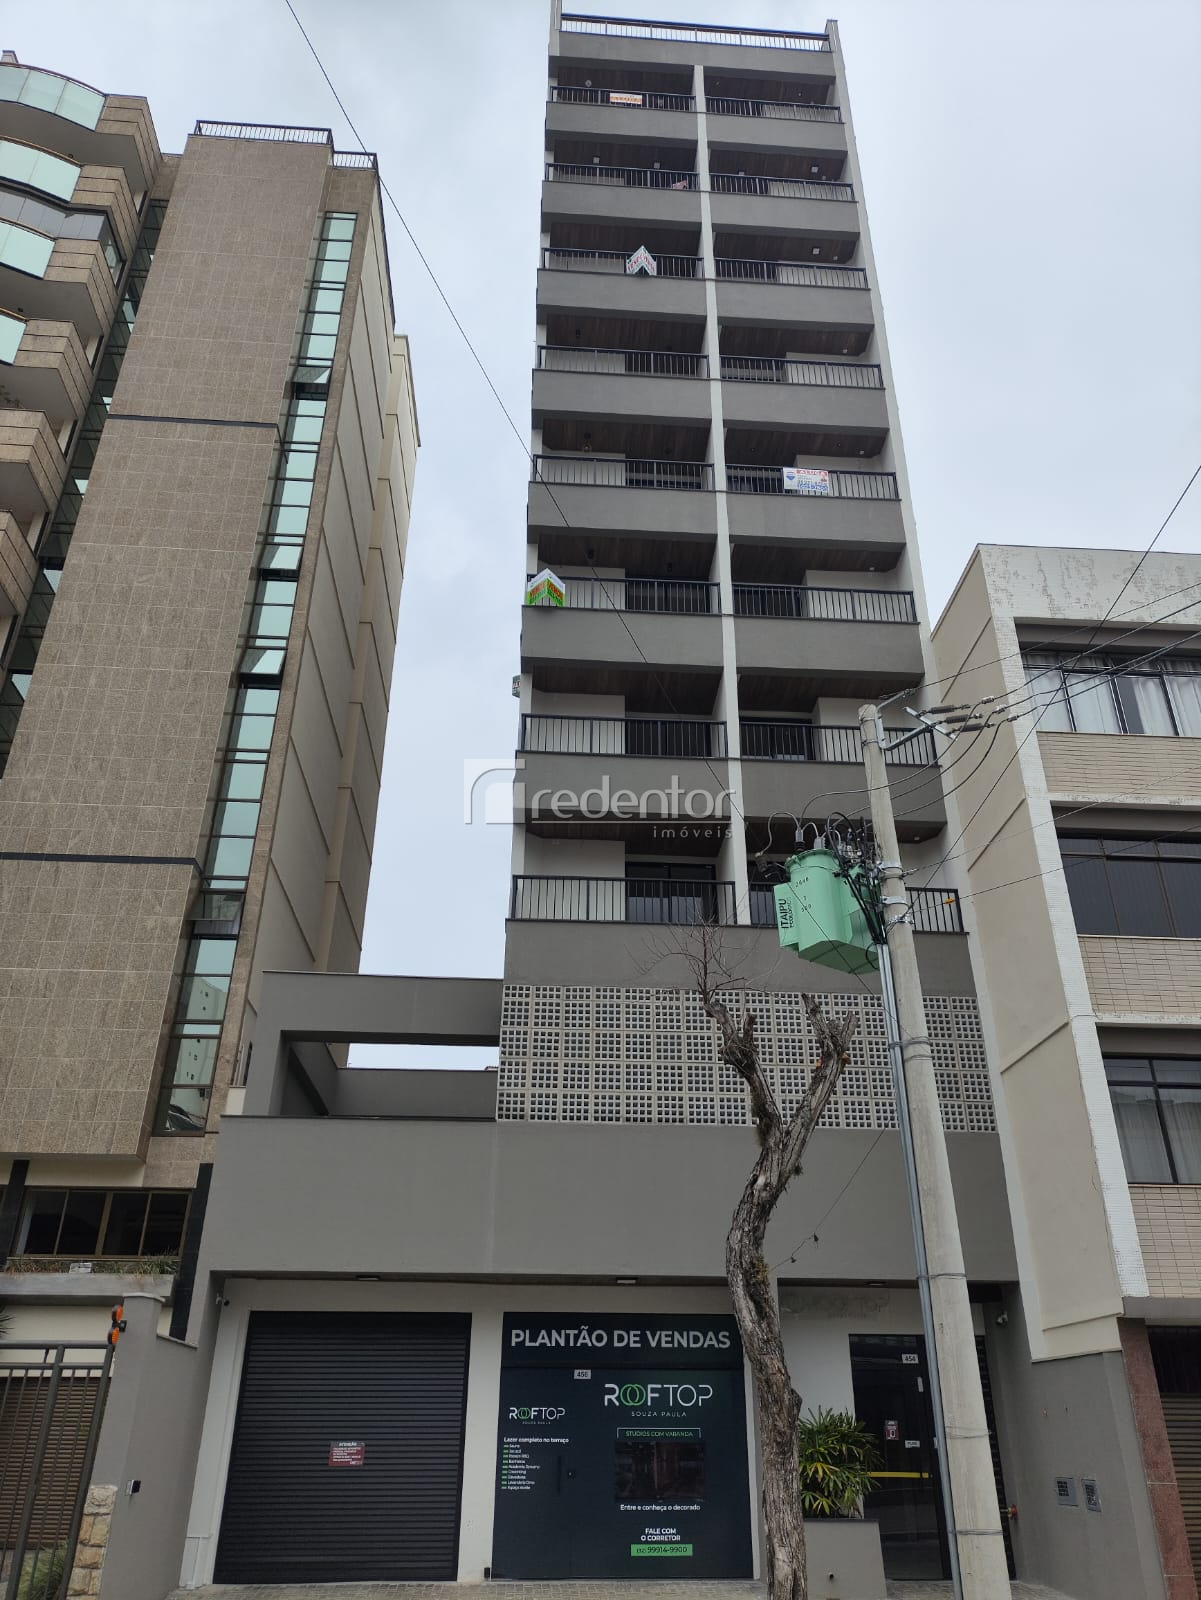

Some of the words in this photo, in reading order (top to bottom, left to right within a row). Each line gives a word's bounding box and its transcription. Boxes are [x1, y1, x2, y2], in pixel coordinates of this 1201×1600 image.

[778, 898, 789, 929] ITAIPU
[511, 1325, 608, 1348] PLANTÃO
[613, 1330, 641, 1348] DE
[646, 1330, 731, 1349] VENDAS
[604, 1383, 713, 1407] ROOFTOP
[509, 1407, 566, 1420] ROOFTOP
[642, 1503, 667, 1512] conheça
[673, 1503, 701, 1511] decorado
